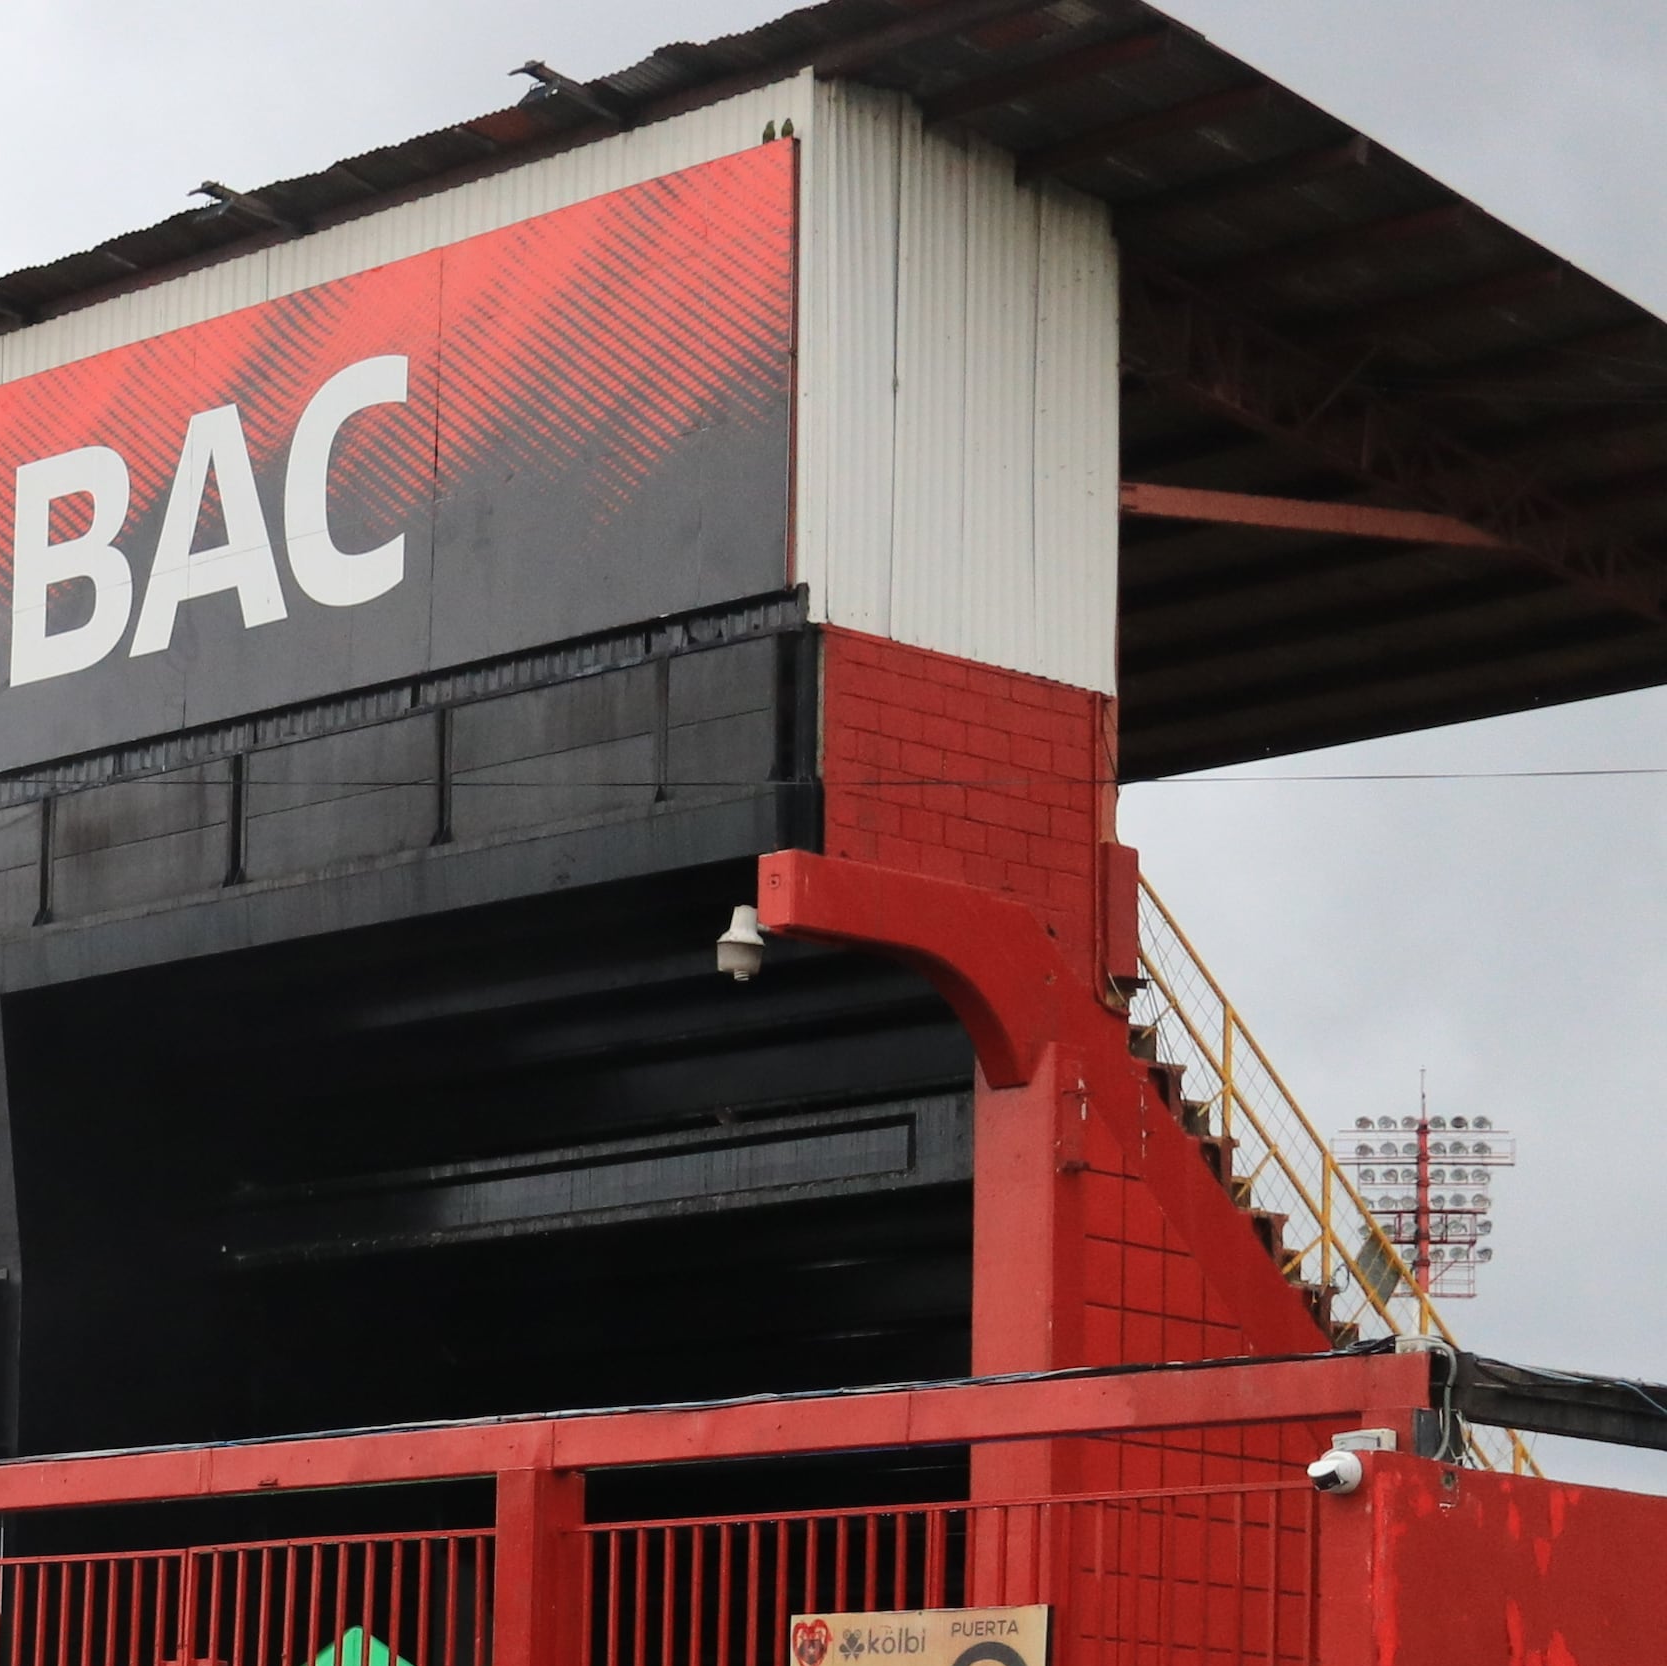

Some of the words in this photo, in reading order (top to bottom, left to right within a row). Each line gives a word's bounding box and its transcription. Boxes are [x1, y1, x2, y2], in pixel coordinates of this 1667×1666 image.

[10, 355, 408, 687] BAC
[867, 1627, 926, 1654] kölbi
[951, 1620, 1019, 1637] PUERTA
